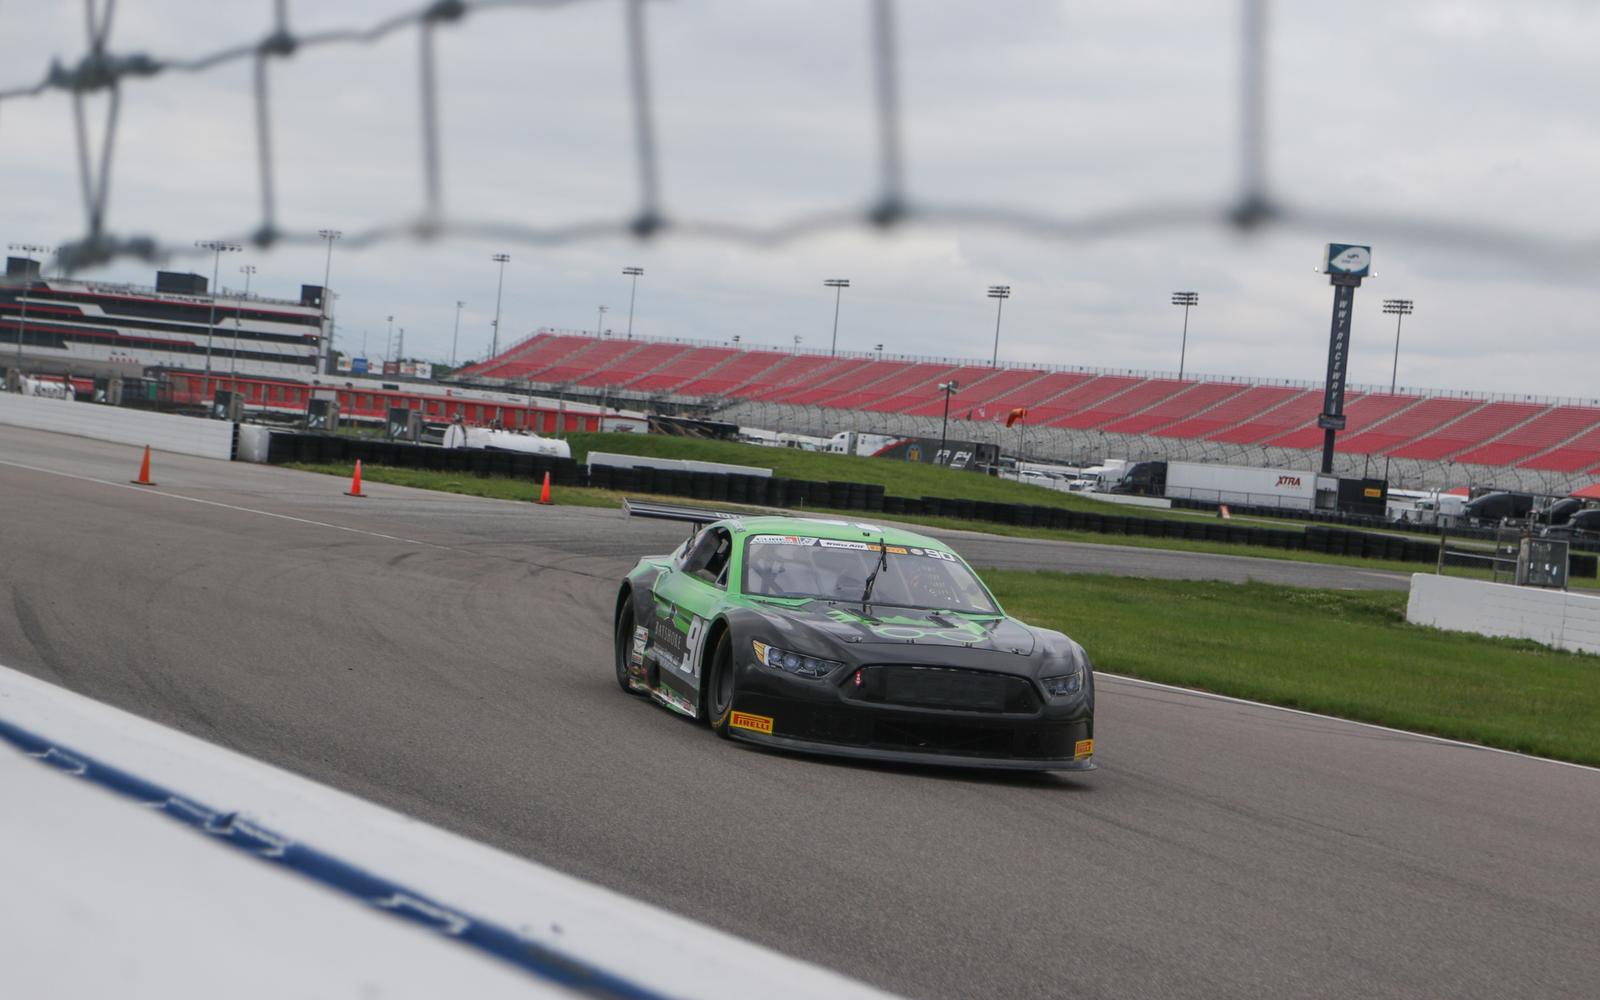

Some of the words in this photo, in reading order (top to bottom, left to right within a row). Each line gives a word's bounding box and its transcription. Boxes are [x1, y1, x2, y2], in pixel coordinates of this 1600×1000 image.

[1338, 300, 1348, 328] WWT
[1330, 332, 1344, 400] RACEWAY
[1275, 475, 1302, 487] XTRA
[924, 548, 956, 562] 90
[736, 715, 770, 731] PIRELLI
